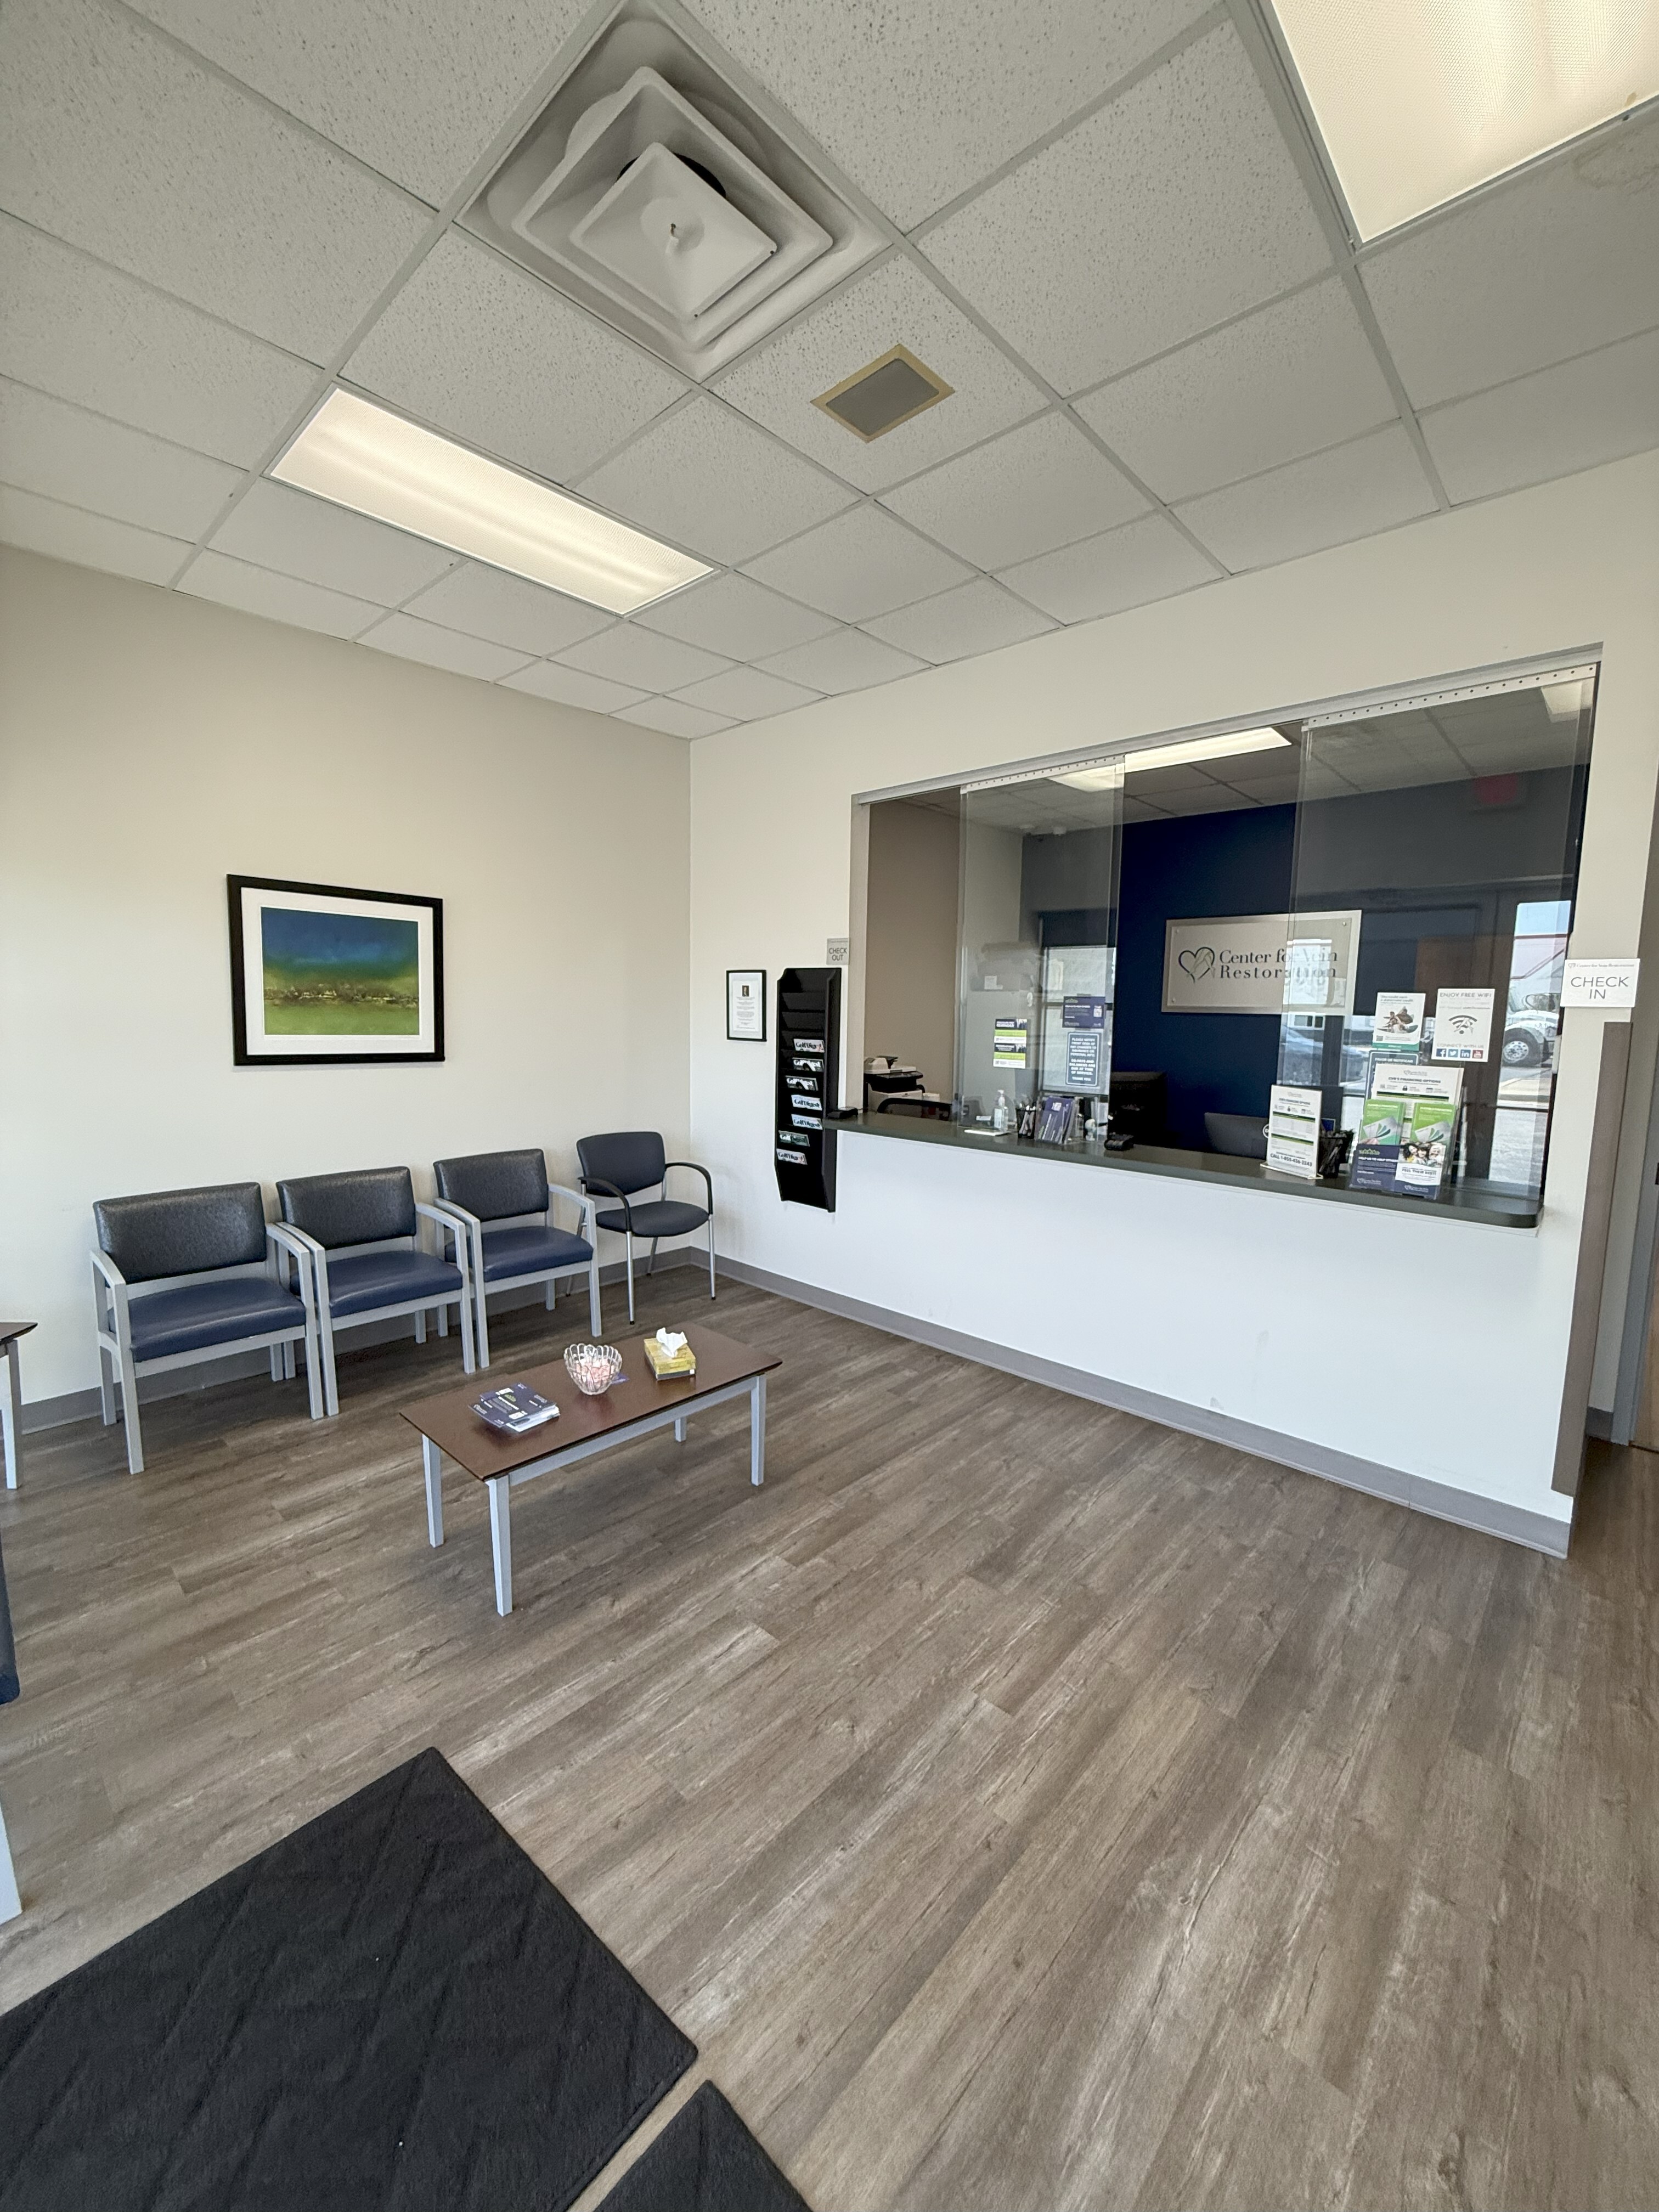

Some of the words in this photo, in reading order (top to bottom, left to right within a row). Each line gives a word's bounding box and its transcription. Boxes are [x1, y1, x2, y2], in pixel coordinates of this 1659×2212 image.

[1220, 950, 1271, 963] Center
[1277, 949, 1300, 963] fo
[1571, 977, 1629, 987] CHECK
[1589, 989, 1606, 999] IN
